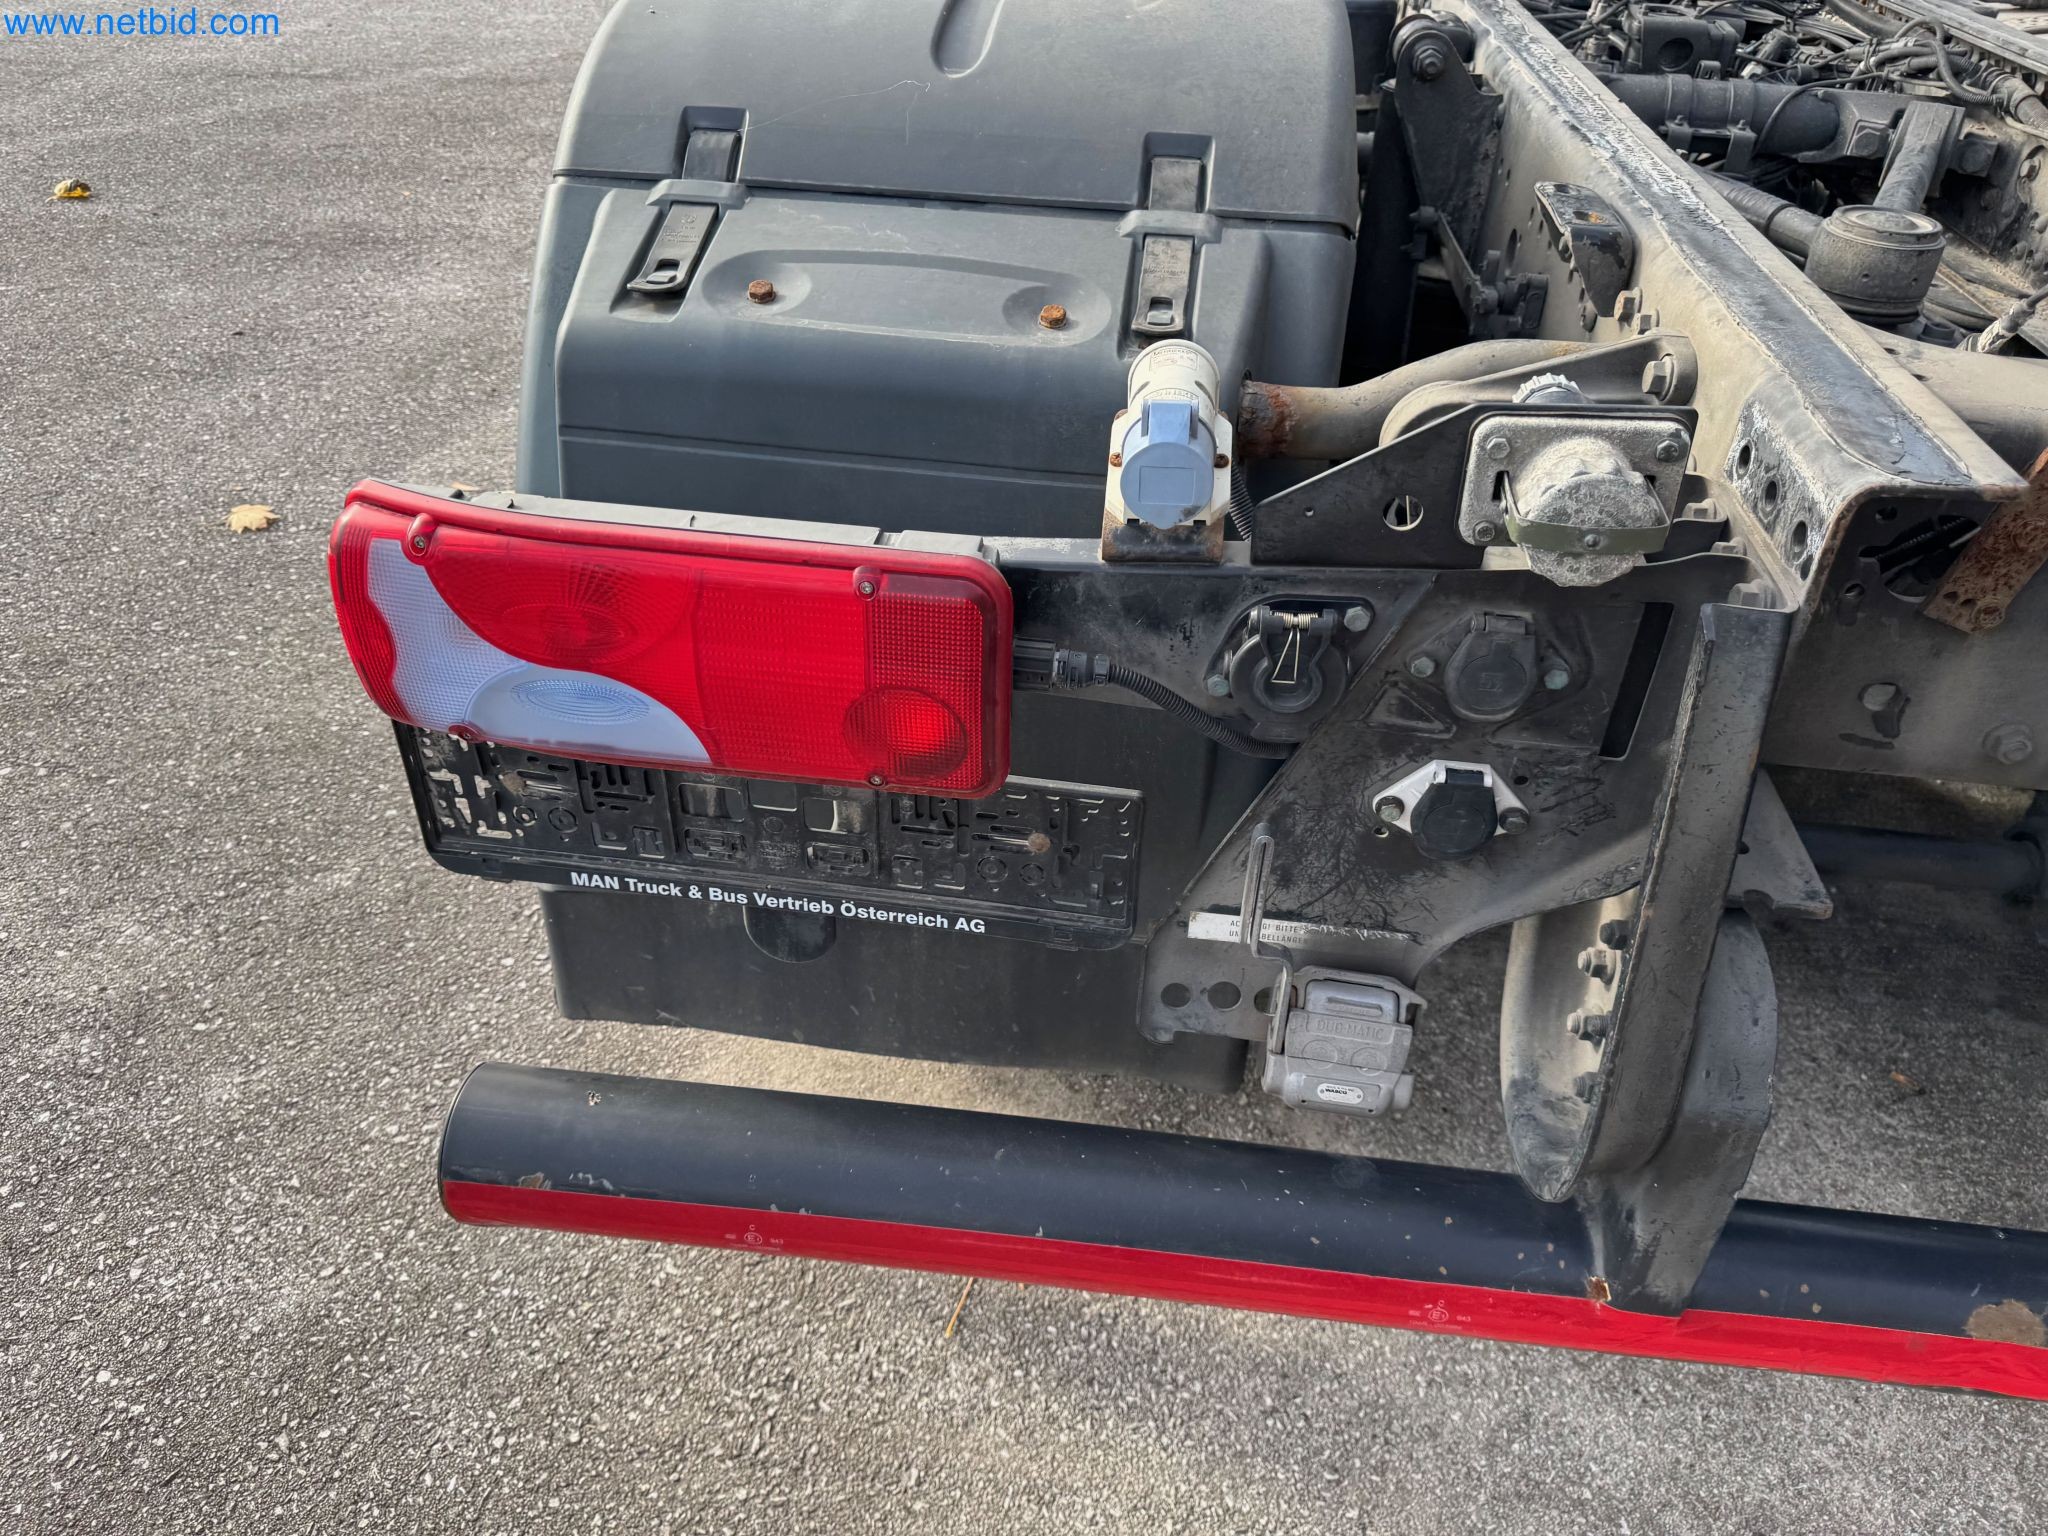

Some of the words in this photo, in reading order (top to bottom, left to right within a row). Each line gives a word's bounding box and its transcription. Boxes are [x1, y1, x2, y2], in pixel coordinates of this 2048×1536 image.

[570, 872, 620, 889] MAN
[625, 877, 682, 897] Truck
[688, 885, 703, 899] &
[708, 887, 748, 904] Bus
[753, 892, 834, 915] Vertrieb
[840, 900, 948, 928] Österreich
[954, 917, 986, 933] AG
[1275, 924, 1298, 933] BITTE
